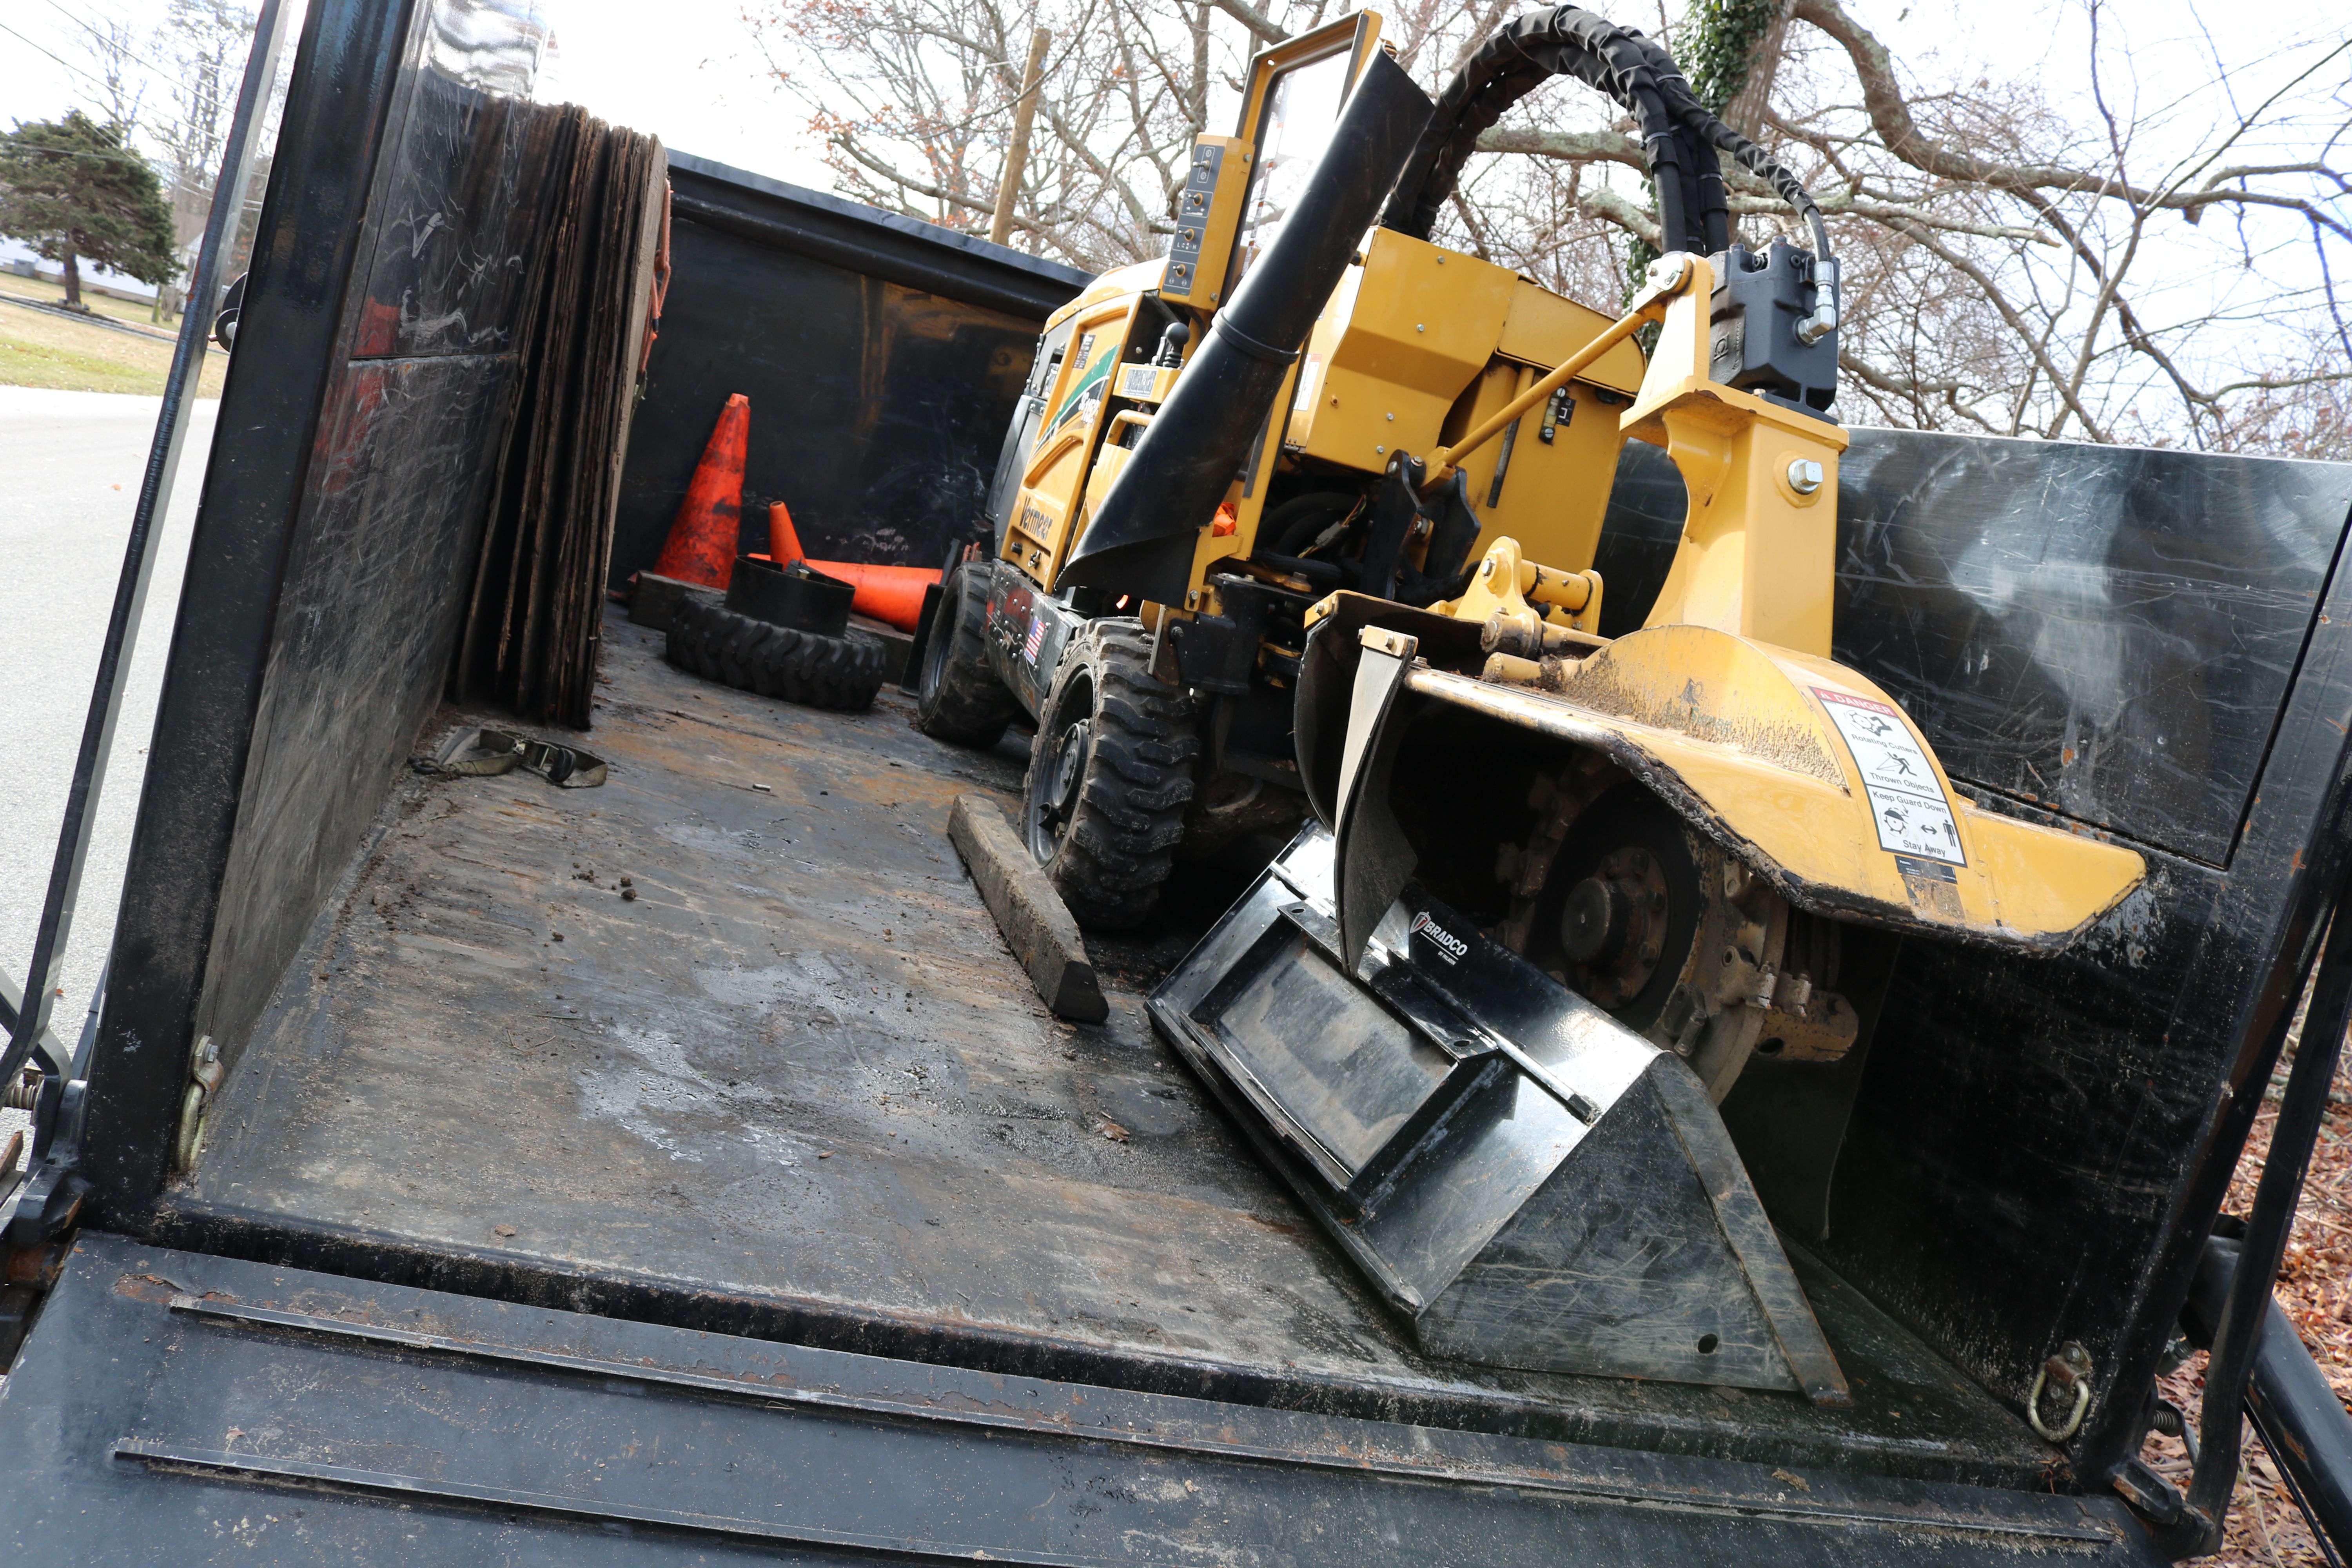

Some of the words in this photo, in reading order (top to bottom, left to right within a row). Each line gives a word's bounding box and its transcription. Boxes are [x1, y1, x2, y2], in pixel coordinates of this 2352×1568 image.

[1020, 495, 1053, 541] Vermeer
[1833, 694, 1894, 715] DANGER
[1851, 734, 1887, 748] Rotating
[1888, 742, 1918, 755] Cutters
[1869, 772, 1902, 784] Thrown
[1903, 780, 1935, 793] Objects
[1872, 791, 1895, 802] Keep
[1896, 795, 1922, 808] Guard
[1924, 802, 1947, 814] Down
[1903, 840, 1921, 852] Stay
[1925, 844, 1945, 857] Away
[1423, 921, 1468, 956] BRADCO
